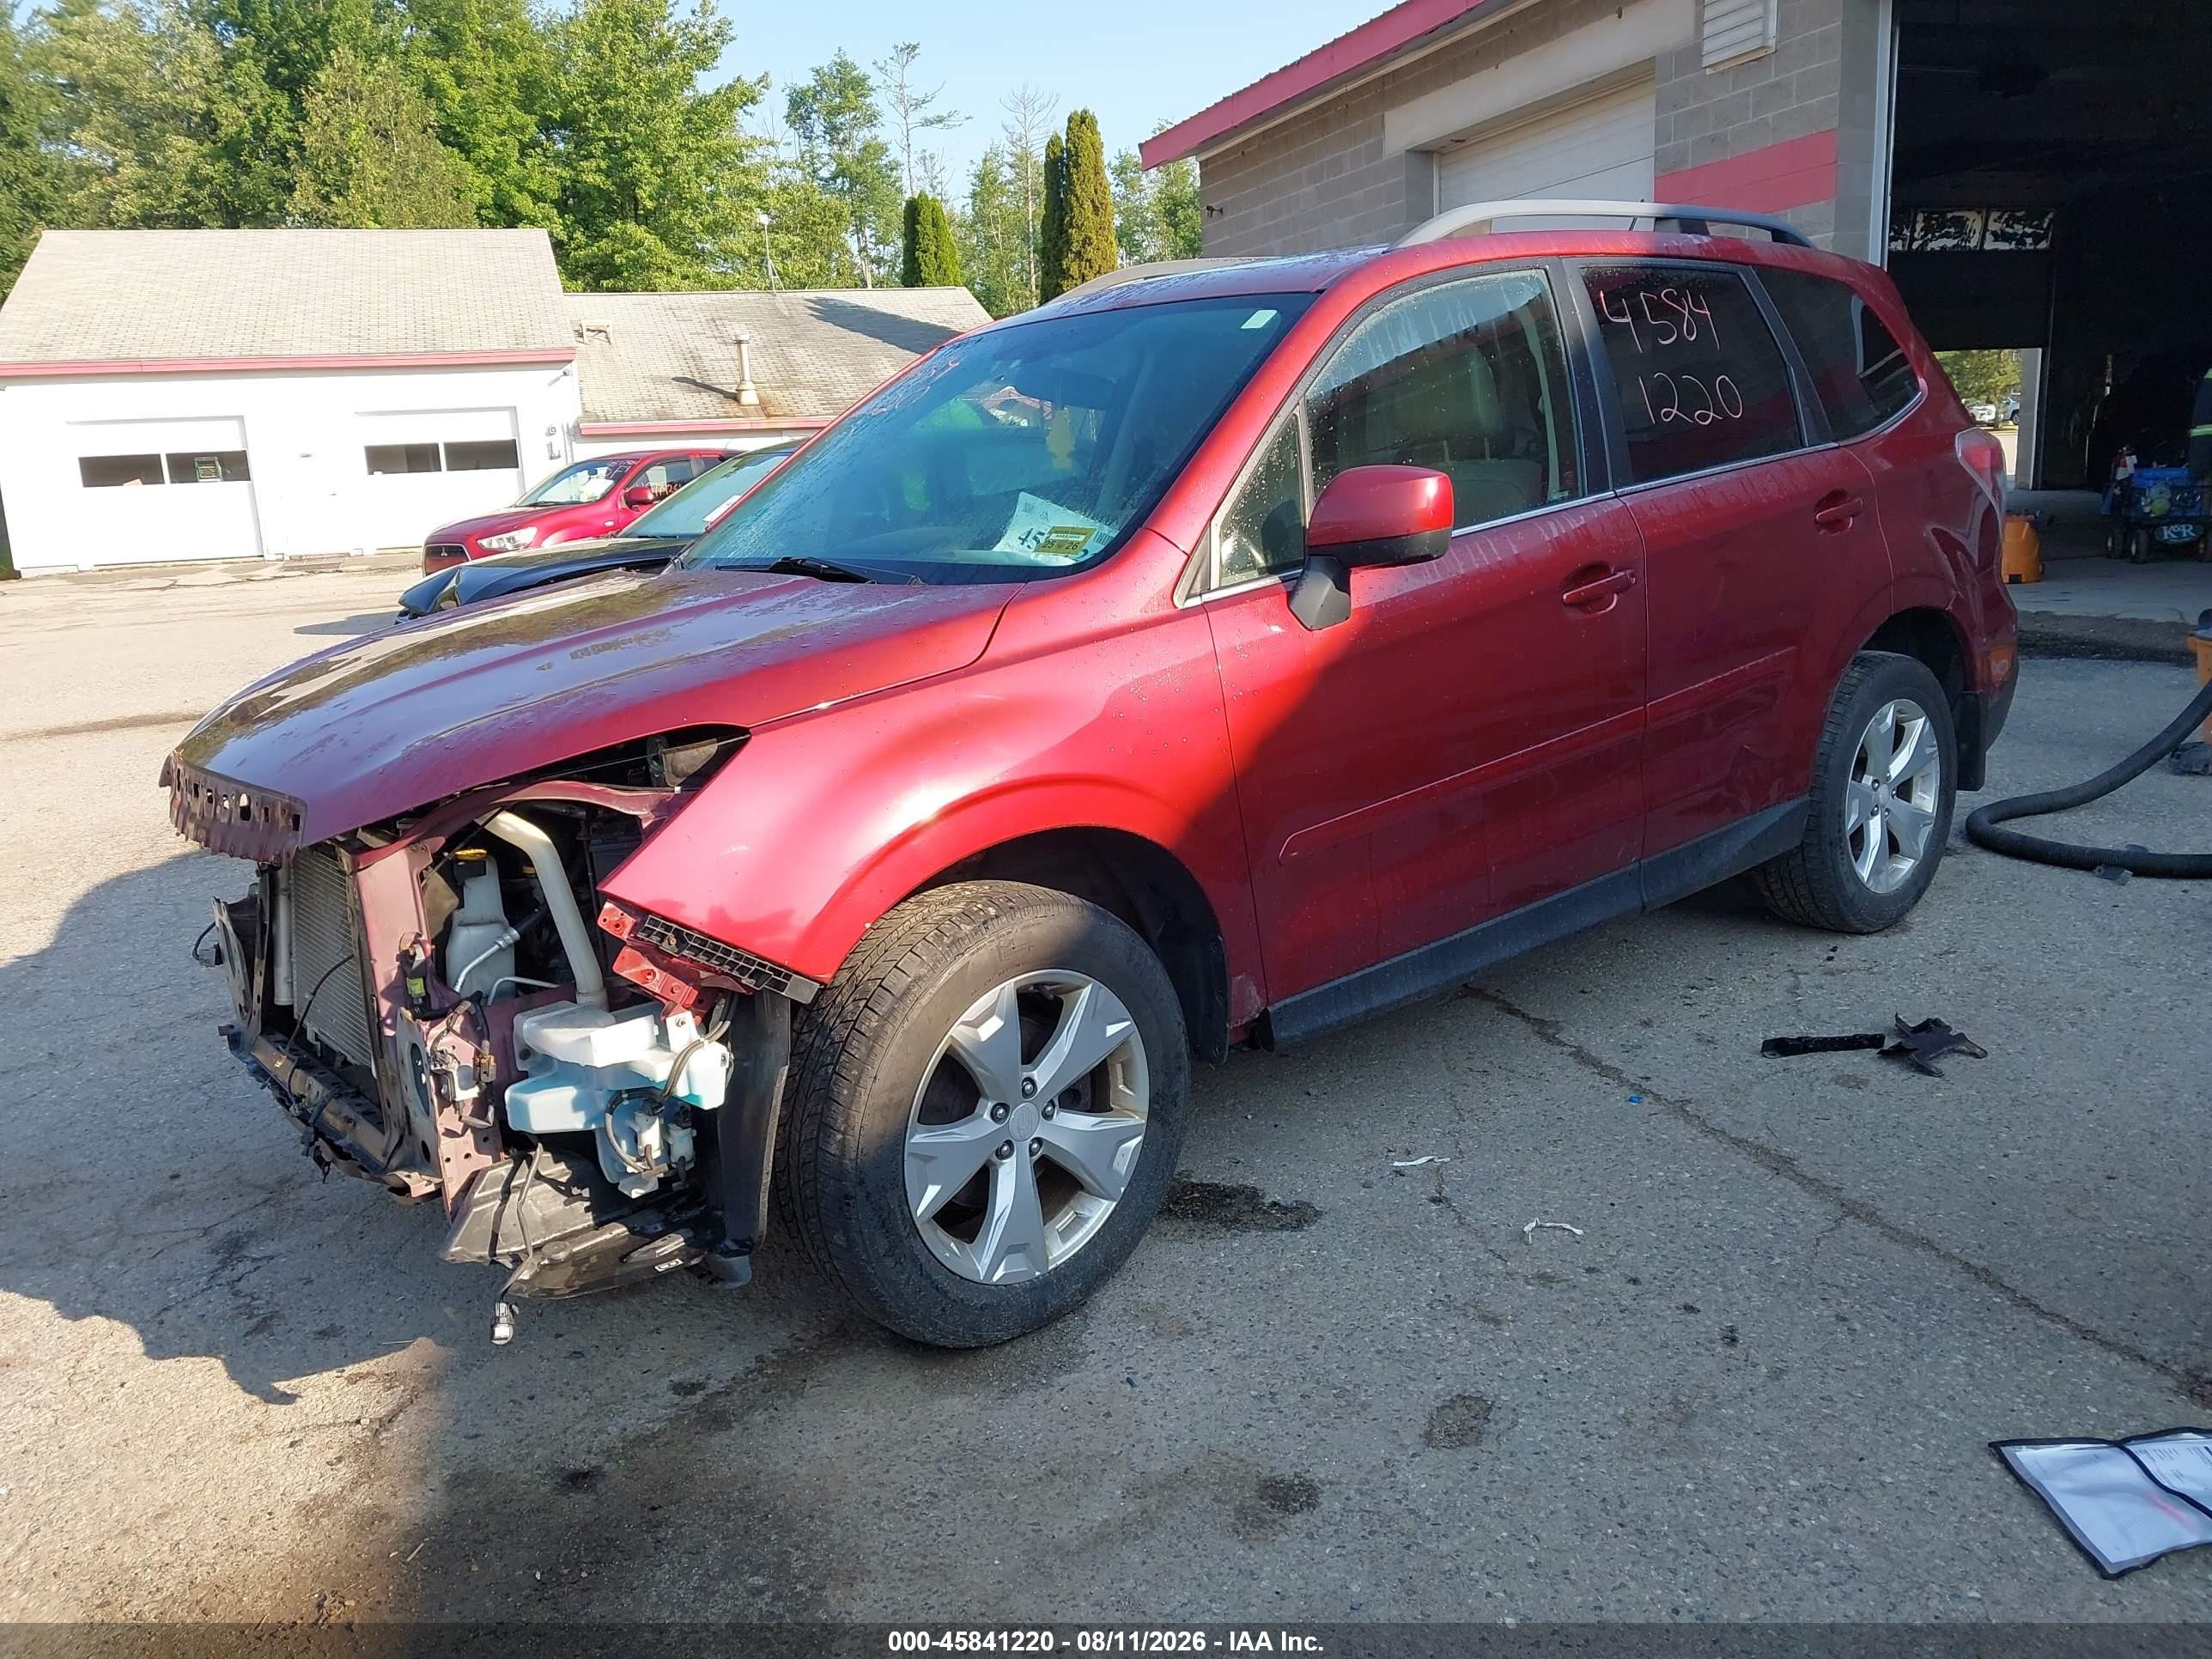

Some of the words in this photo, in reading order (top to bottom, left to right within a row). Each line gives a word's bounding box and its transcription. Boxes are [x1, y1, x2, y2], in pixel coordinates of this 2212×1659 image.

[1600, 289, 1720, 353] 4584
[1638, 372, 1742, 424] 1220
[1065, 541, 1080, 550] 26
[2160, 525, 2196, 539] K&R
